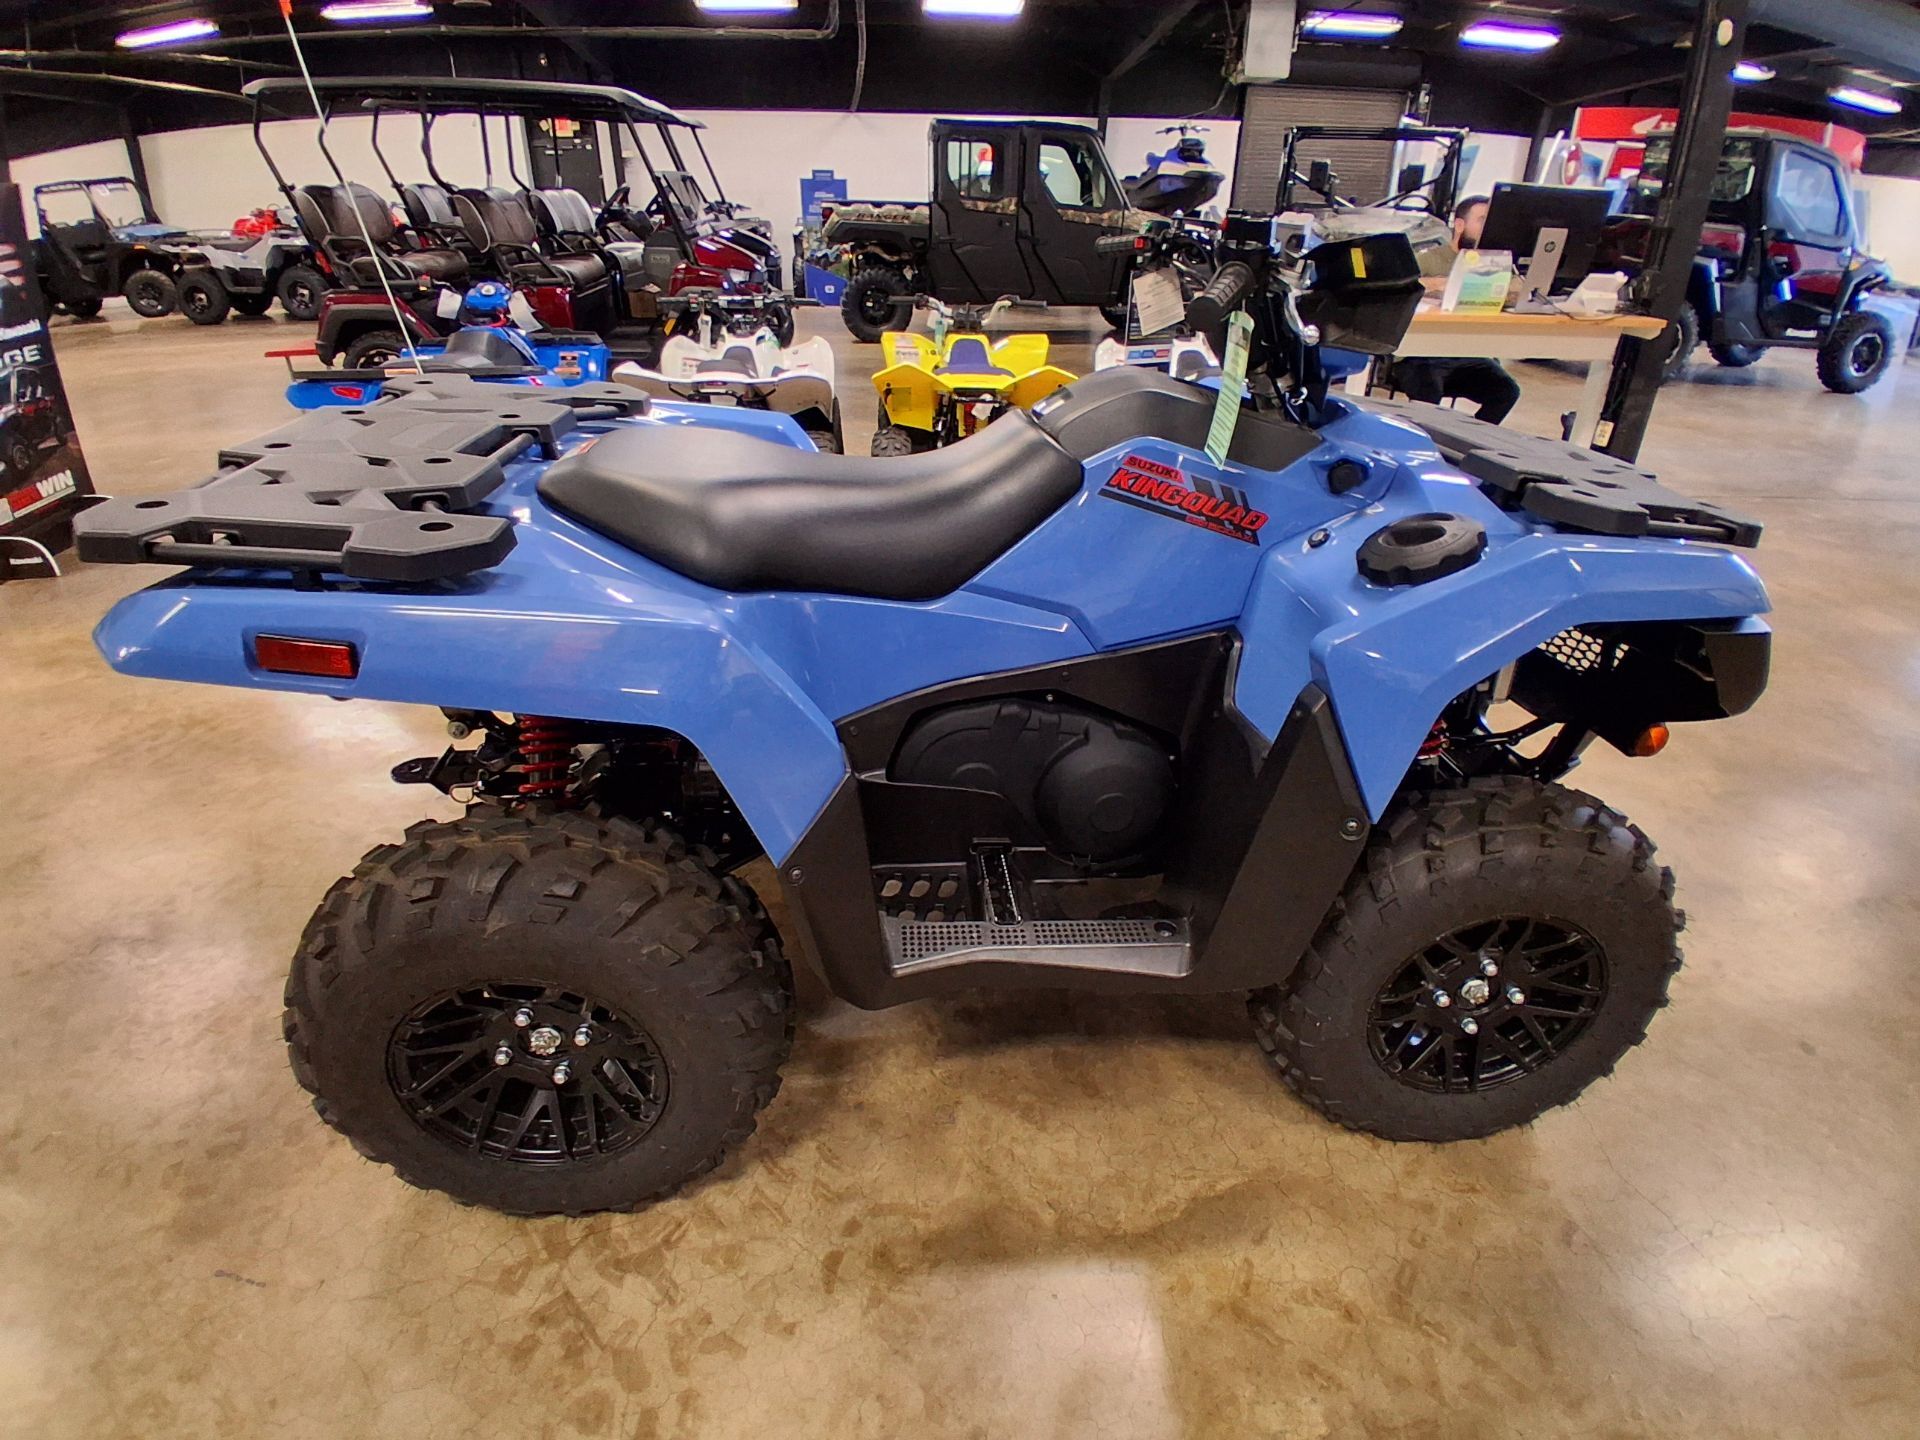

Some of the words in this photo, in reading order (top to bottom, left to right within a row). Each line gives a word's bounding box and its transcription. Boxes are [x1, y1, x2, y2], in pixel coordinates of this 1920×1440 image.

[856, 212, 911, 221] RANGER
[1127, 455, 1181, 480] SUZUKI
[1107, 467, 1270, 531] KINGQUAD
